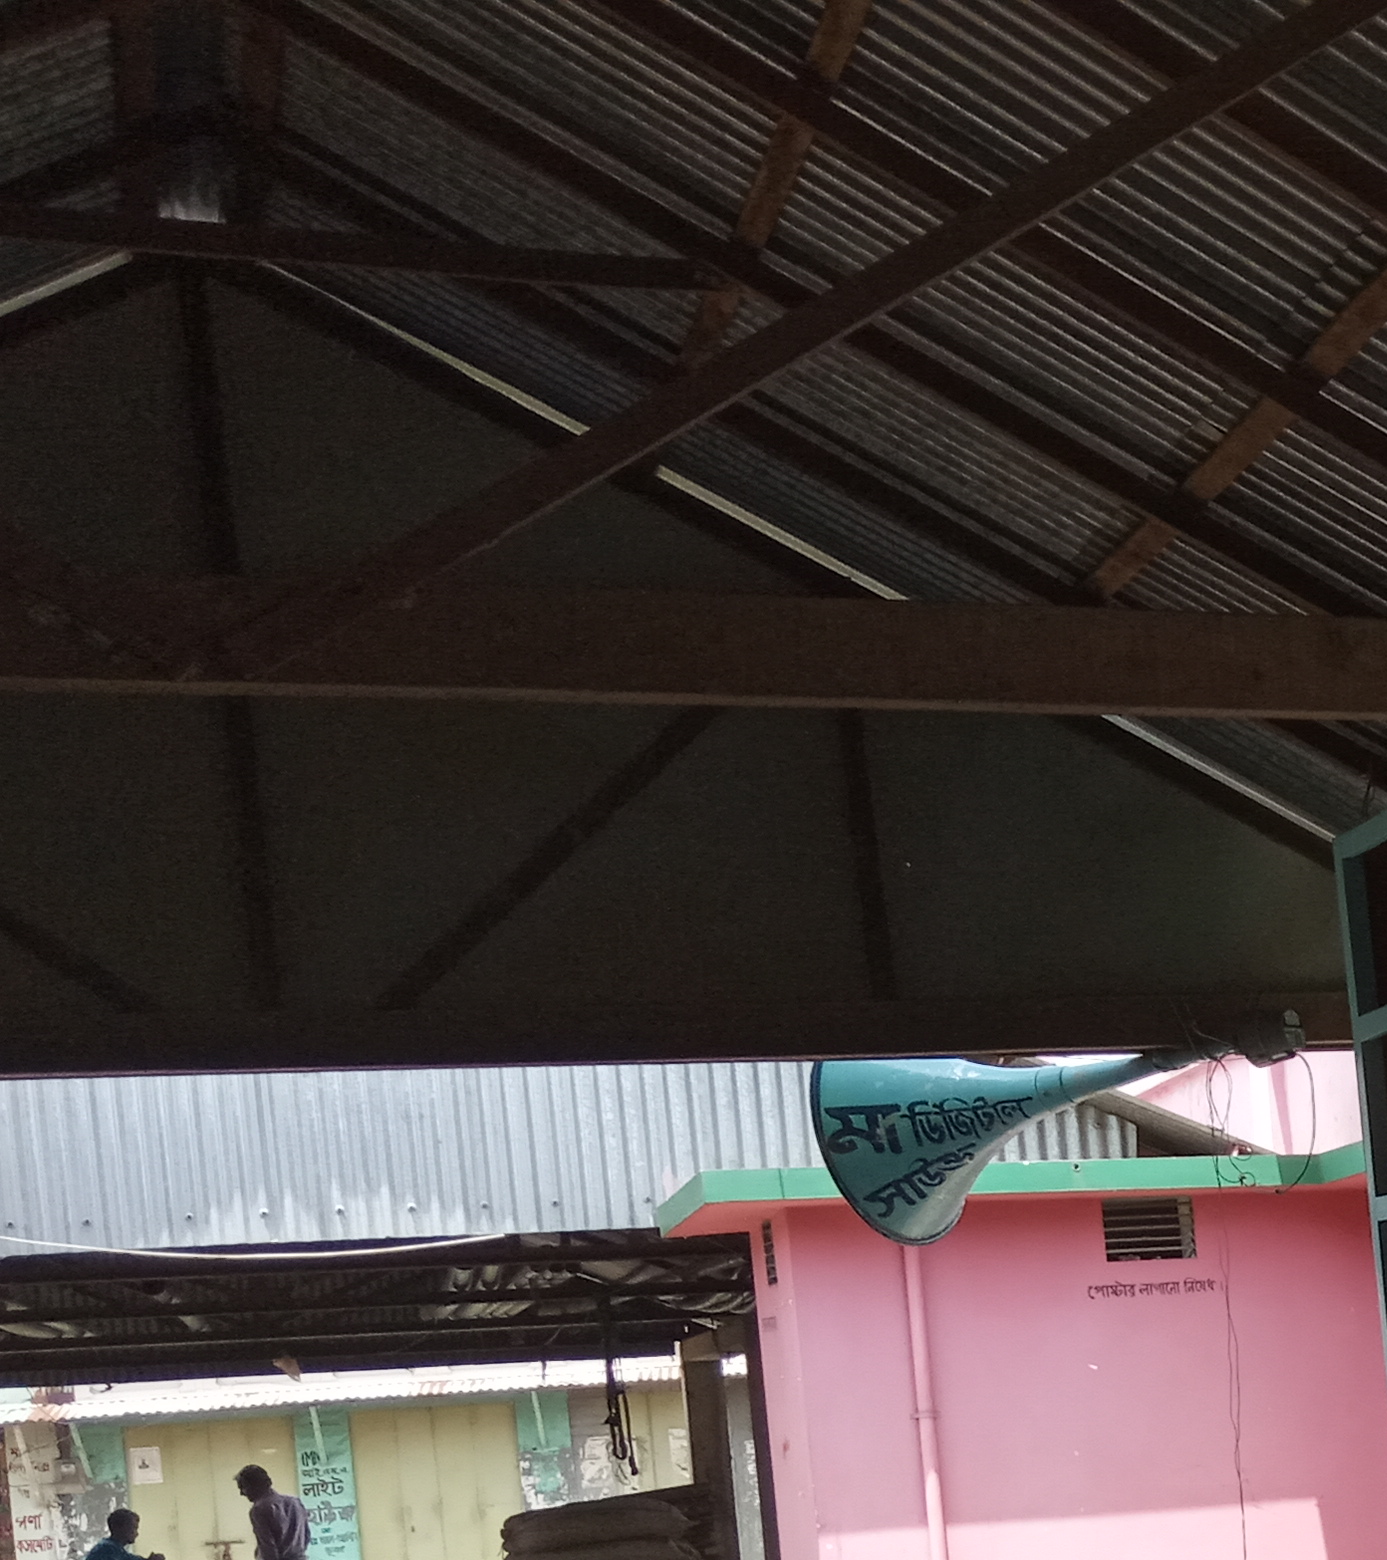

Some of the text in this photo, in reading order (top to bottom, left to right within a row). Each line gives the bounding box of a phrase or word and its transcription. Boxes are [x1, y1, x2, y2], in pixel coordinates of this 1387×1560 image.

[824, 1096, 1033, 1153] মা ডিজিটাল
[302, 1476, 344, 1497] লাইট
